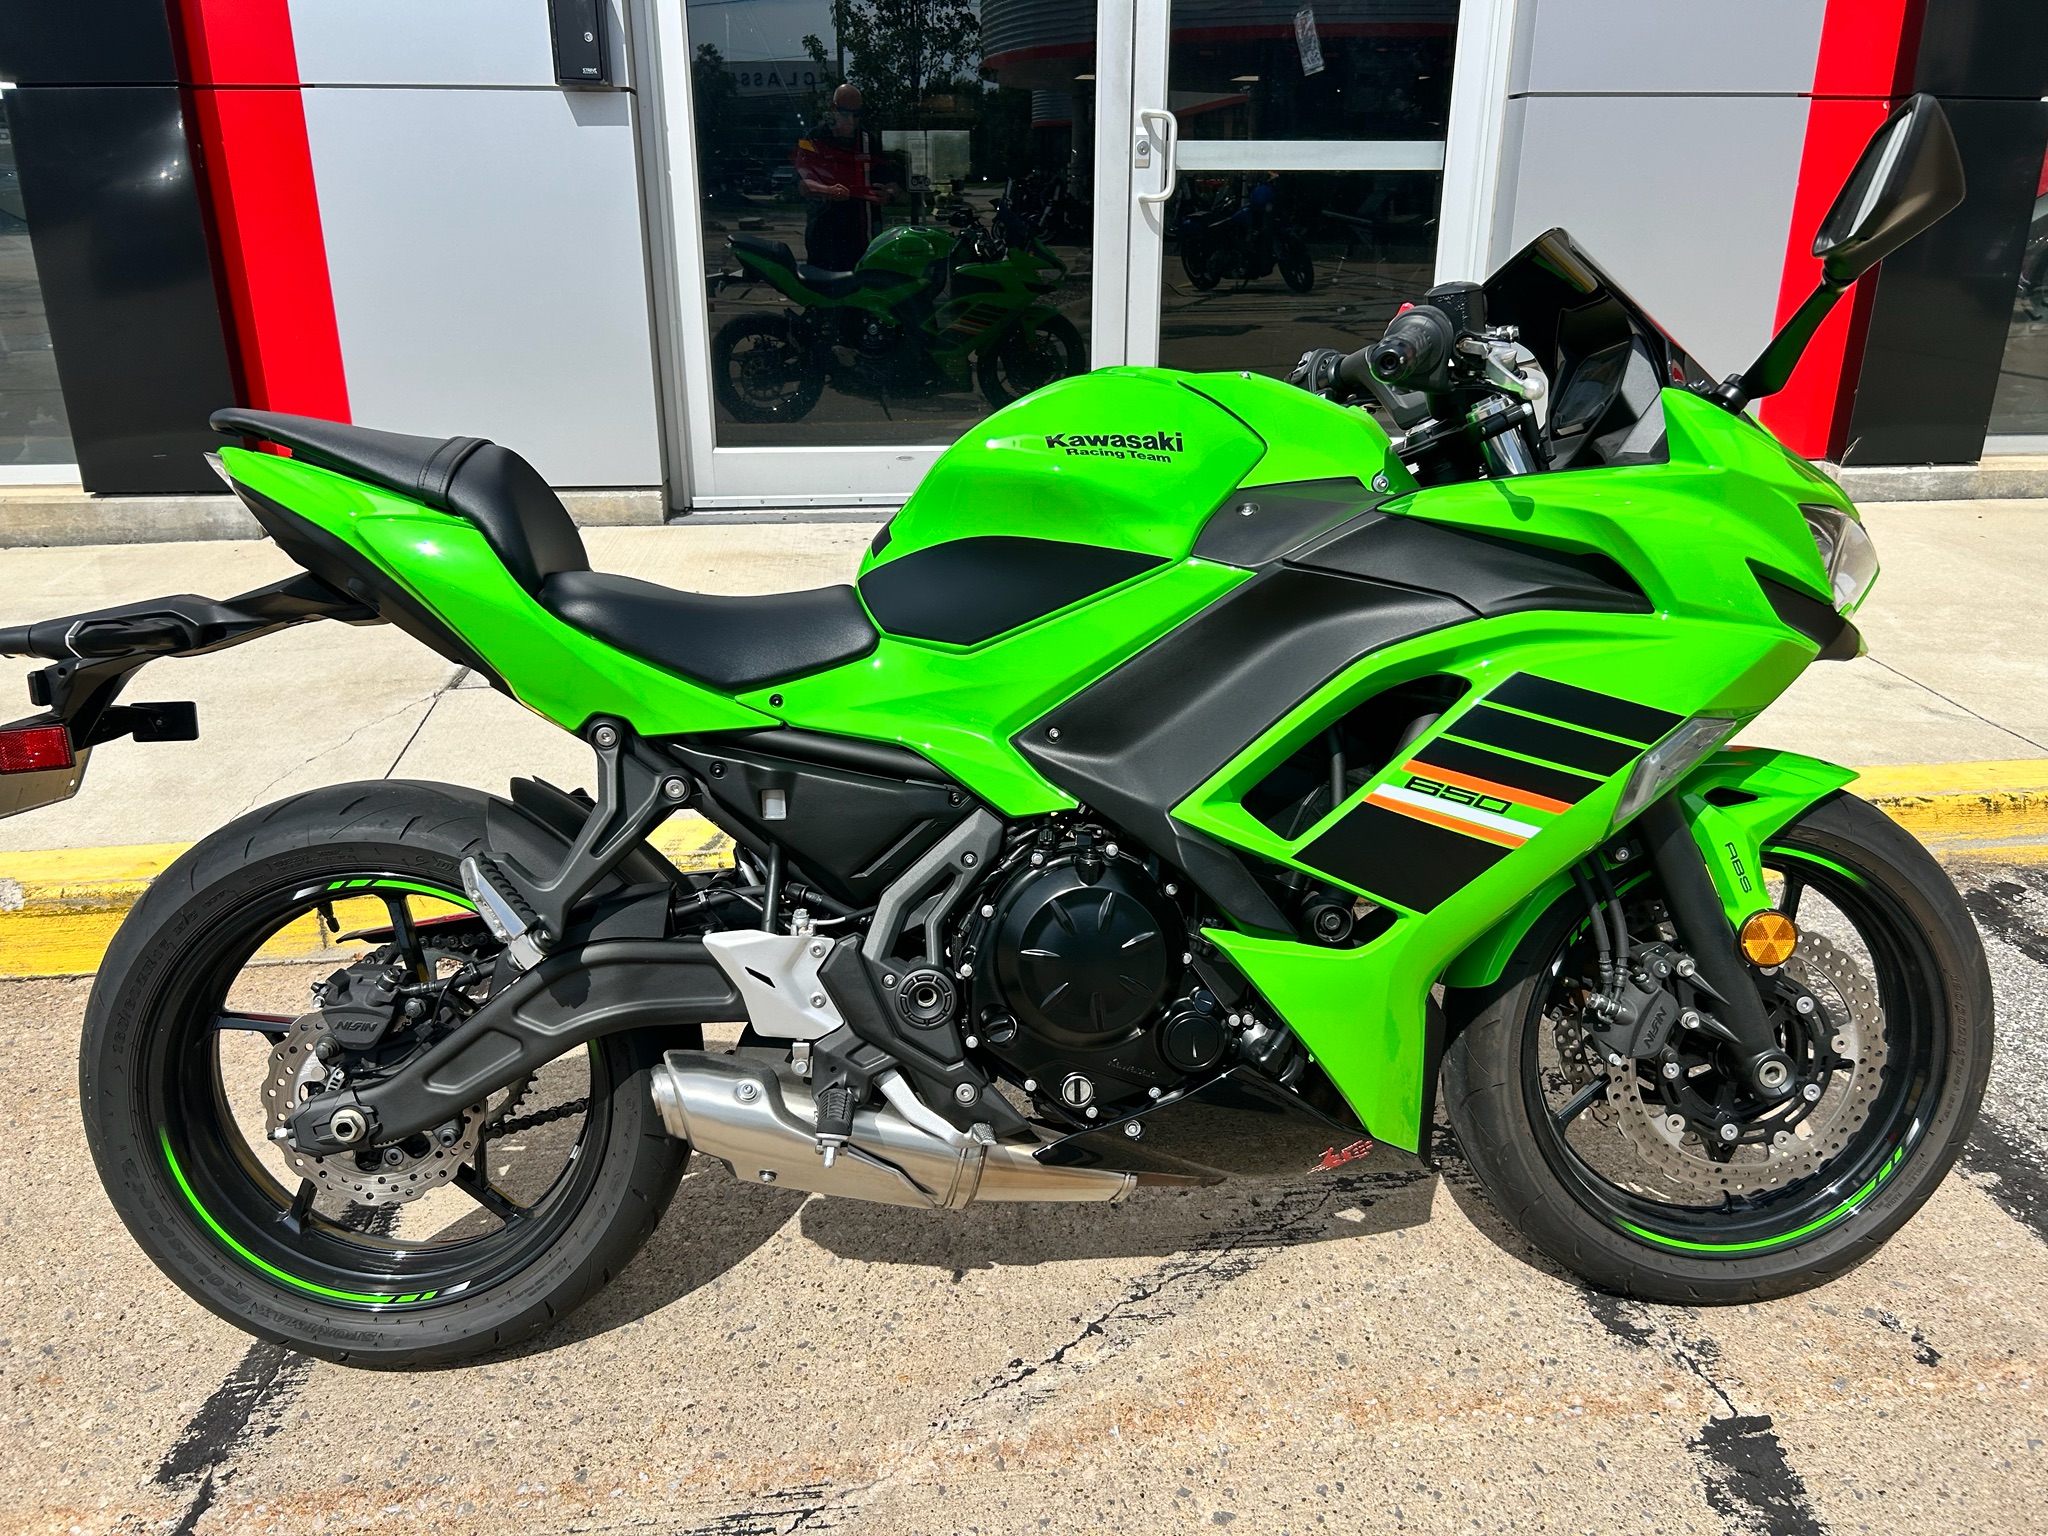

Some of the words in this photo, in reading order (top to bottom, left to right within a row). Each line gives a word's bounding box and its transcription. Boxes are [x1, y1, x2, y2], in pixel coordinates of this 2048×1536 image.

[1044, 430, 1184, 453] Kawasaki
[1065, 447, 1126, 460] Racing
[1126, 449, 1172, 464] Team
[1403, 775, 1513, 815] 650
[1724, 841, 1752, 894] ABS
